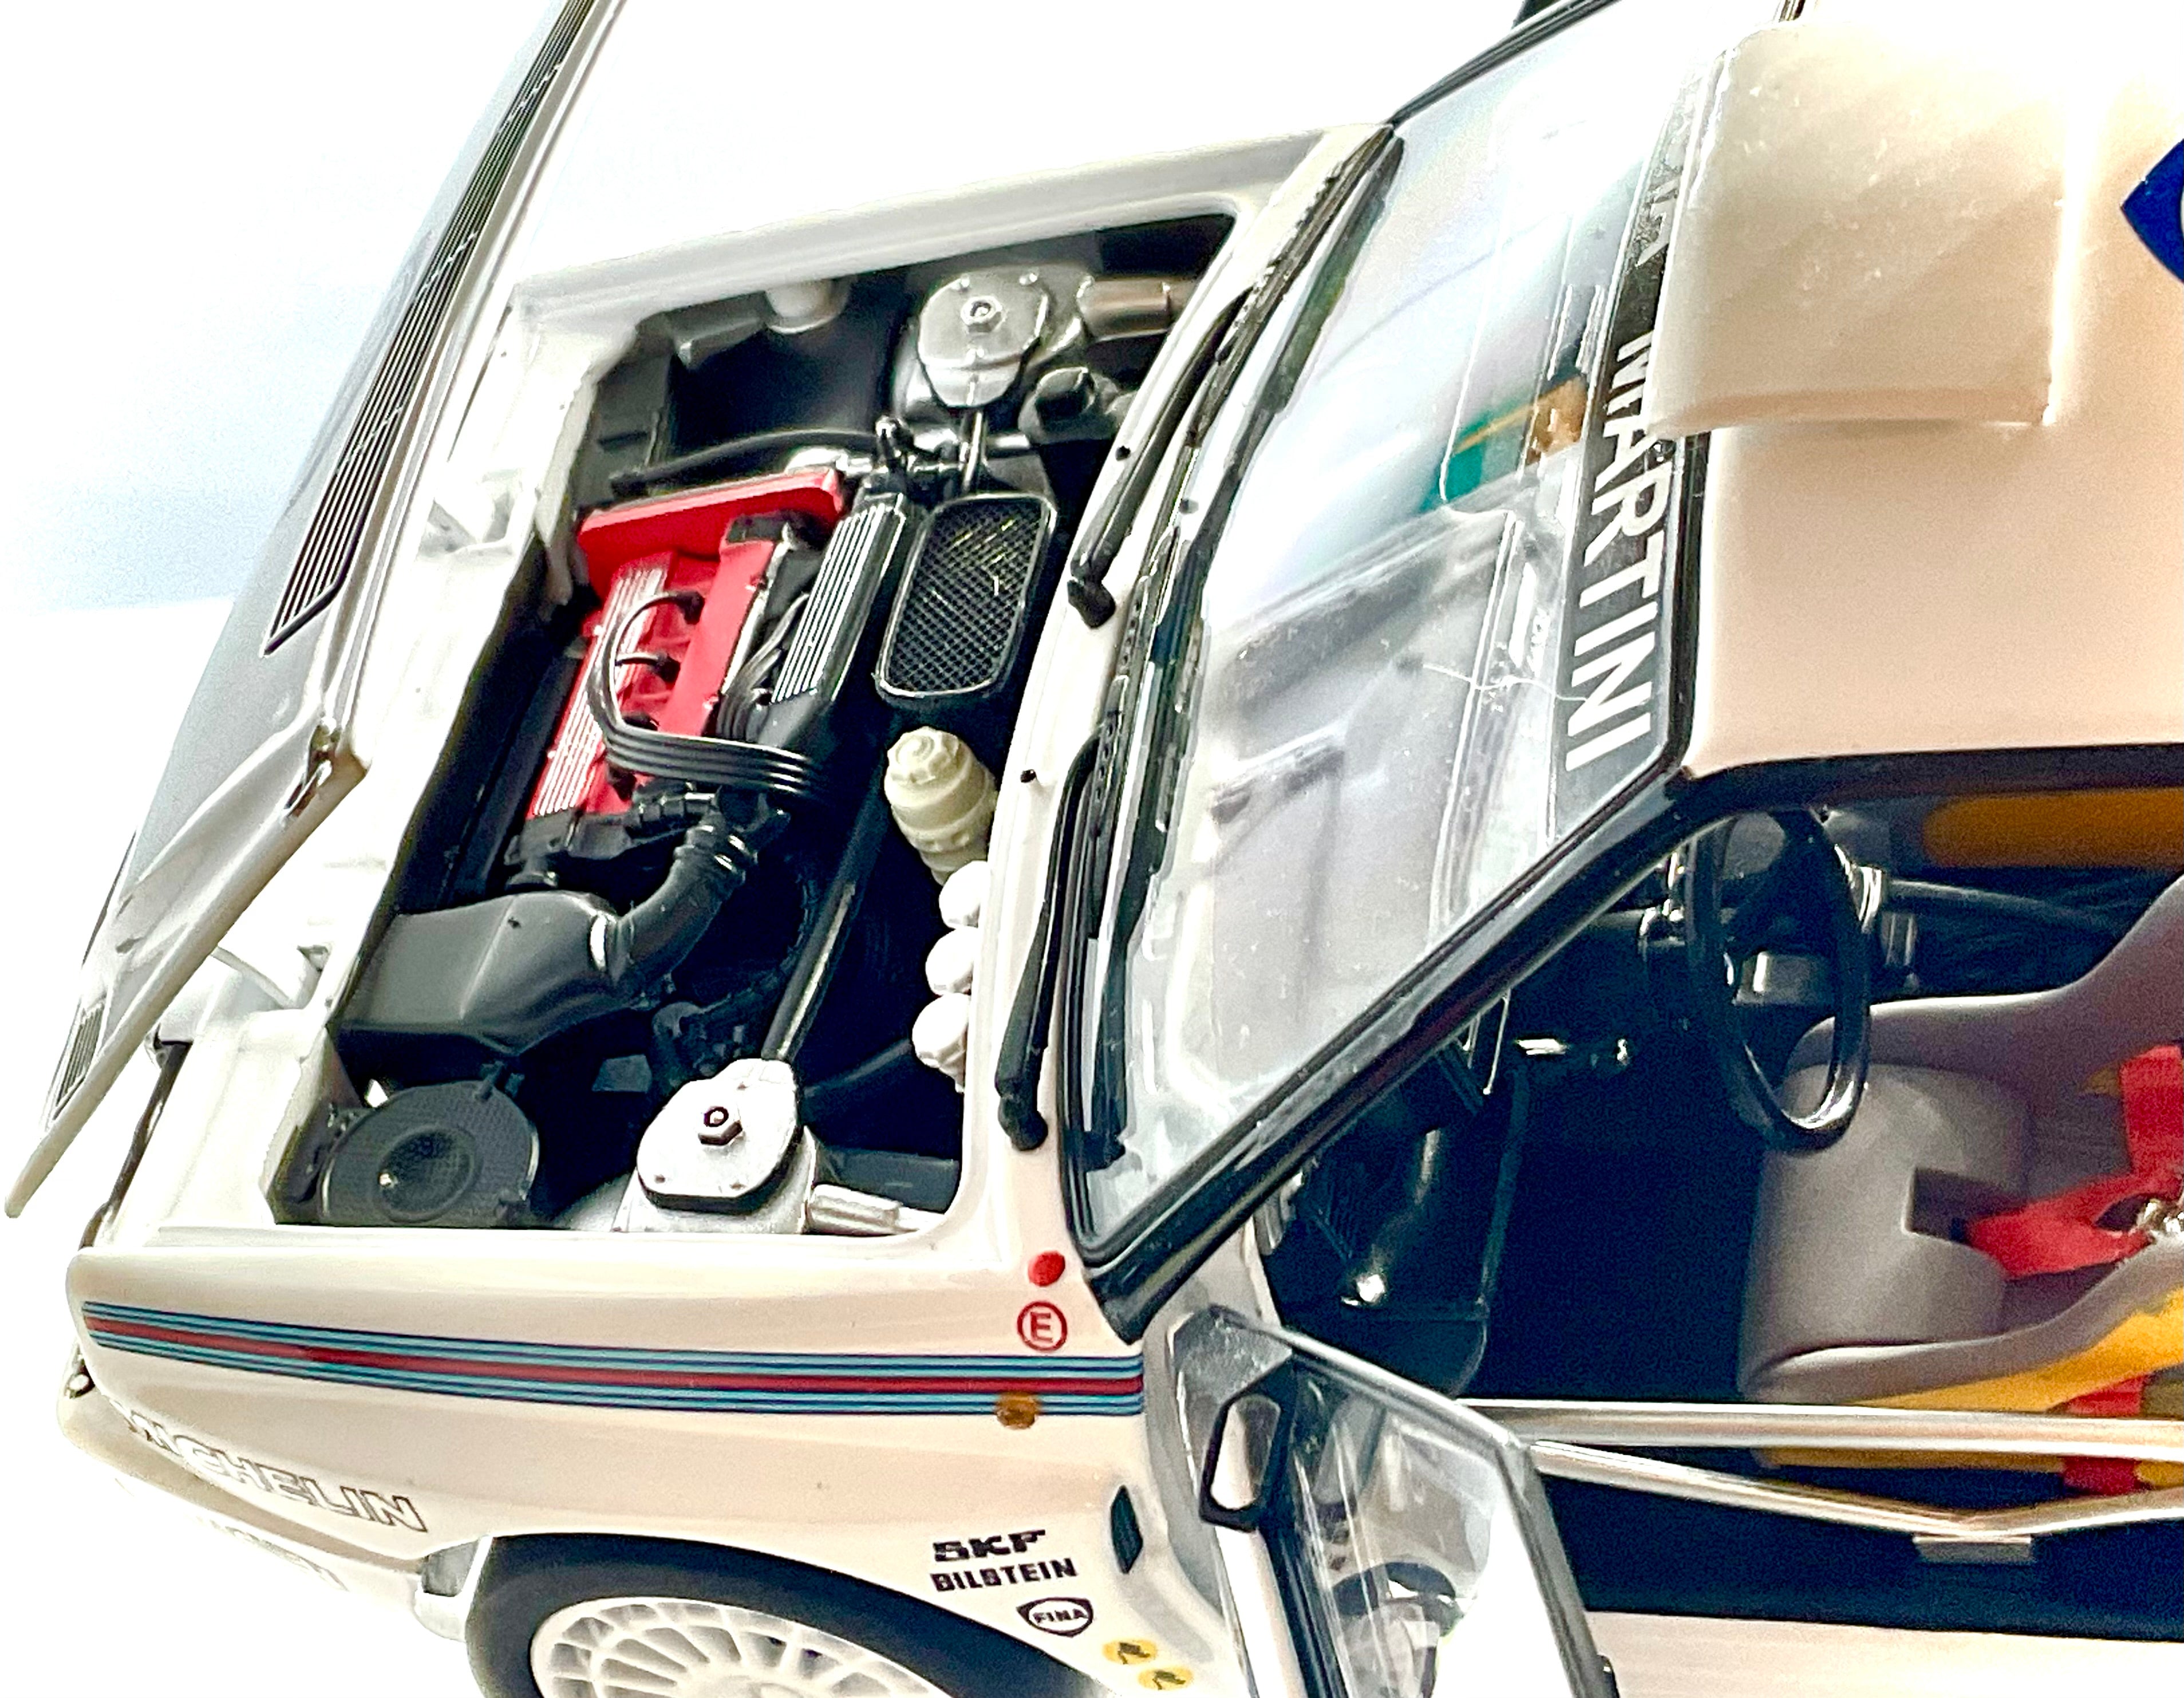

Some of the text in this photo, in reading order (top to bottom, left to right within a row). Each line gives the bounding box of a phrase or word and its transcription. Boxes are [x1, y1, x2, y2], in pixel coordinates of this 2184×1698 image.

[1030, 1311, 1053, 1343] E
[933, 1529, 1046, 1562] SKF
[930, 1558, 1078, 1592] BILSTEIN
[1032, 1608, 1088, 1624] FINA
